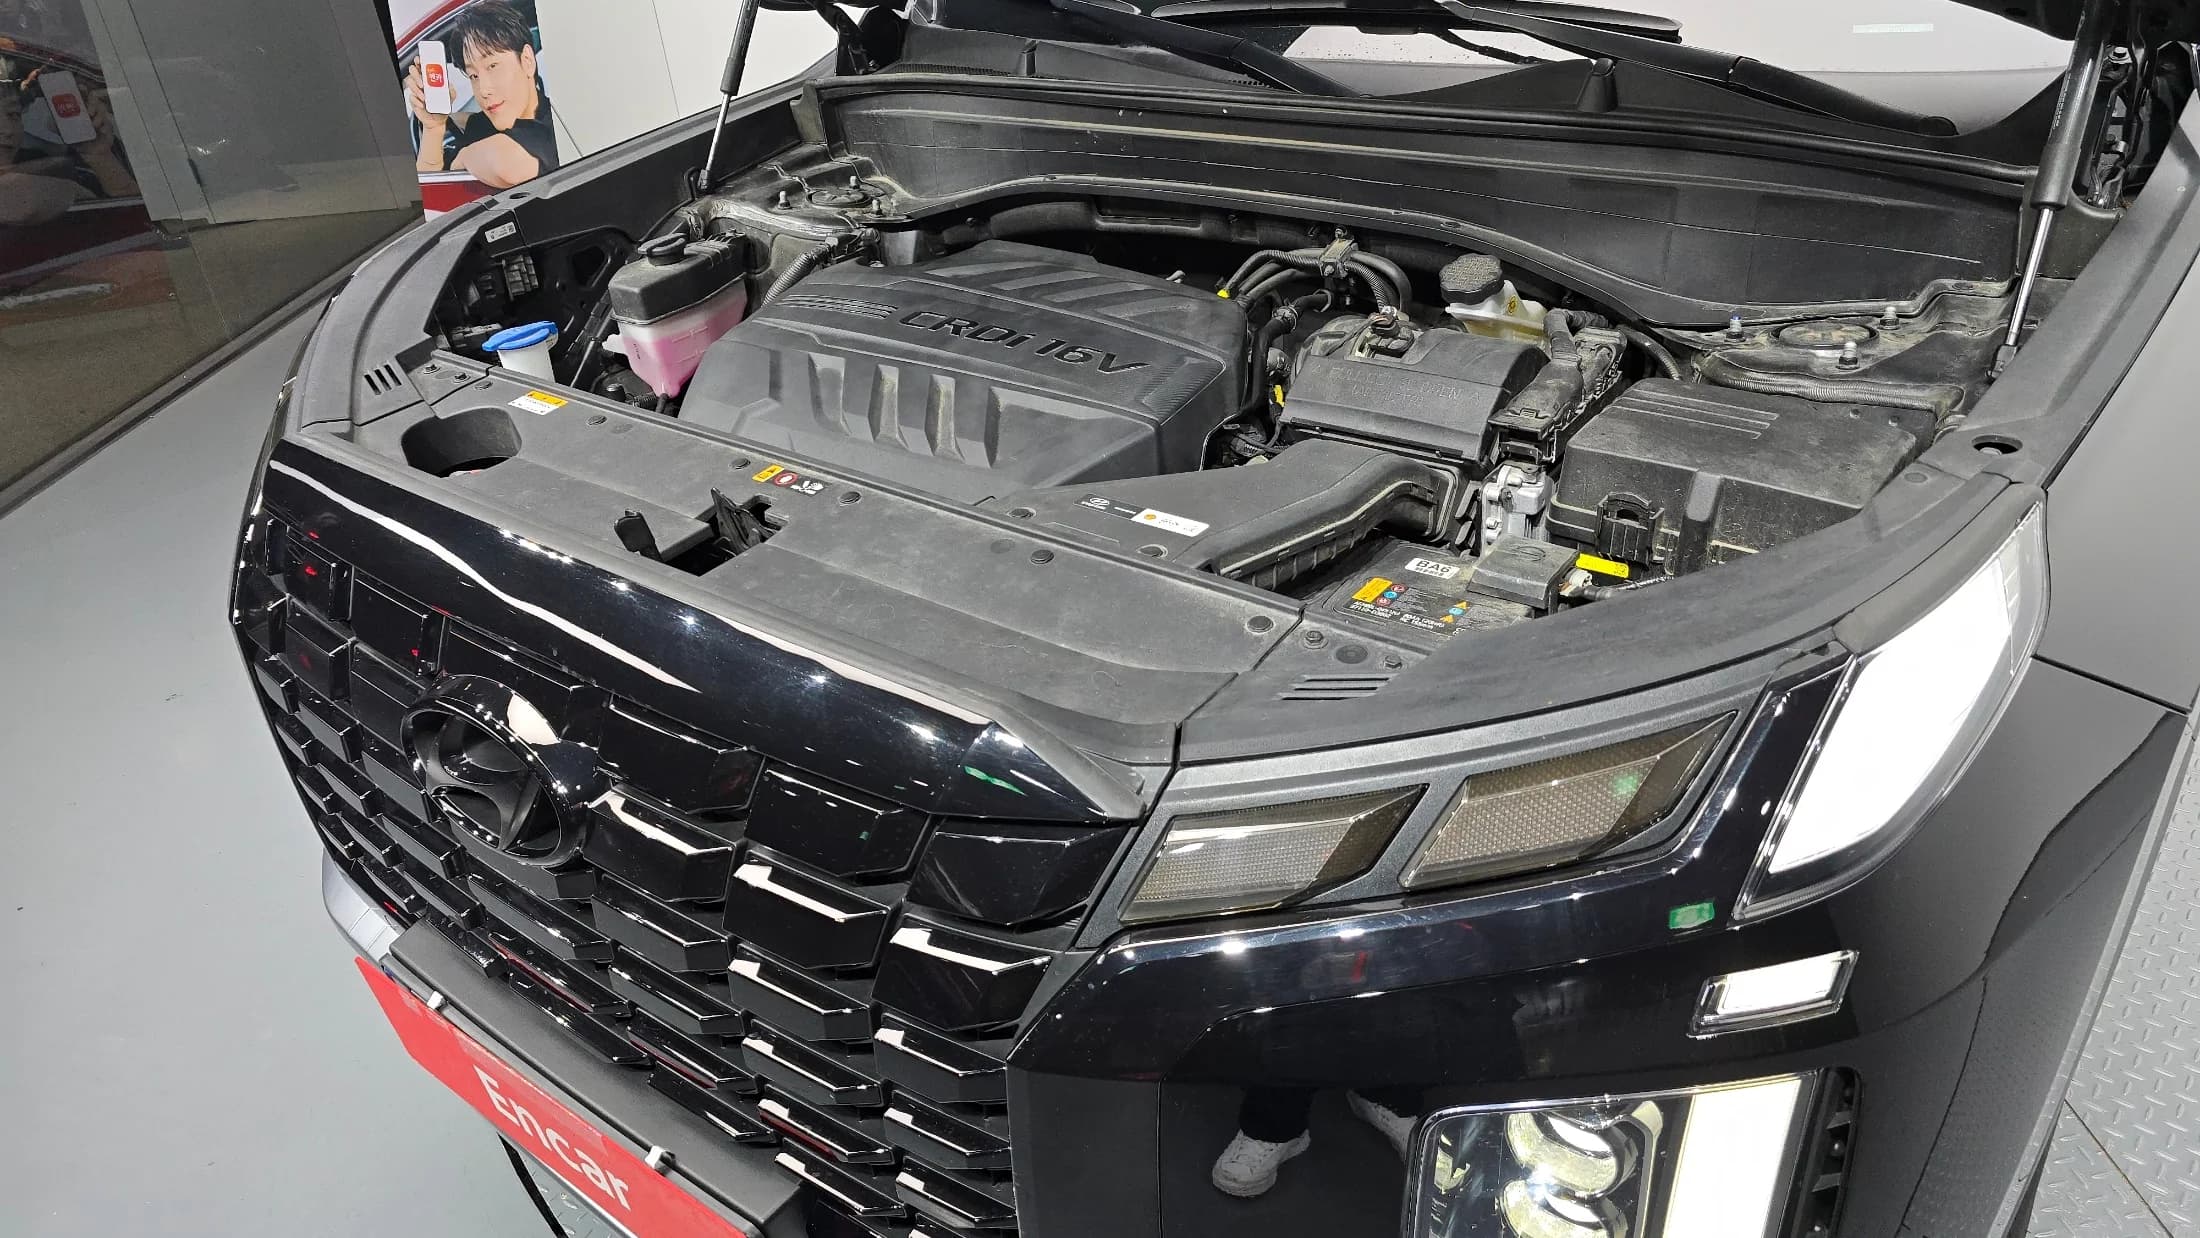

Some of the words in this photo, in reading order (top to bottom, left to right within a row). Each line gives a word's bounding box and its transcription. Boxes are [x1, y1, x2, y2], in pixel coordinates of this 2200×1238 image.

[899, 310, 1037, 349] CRDi
[1034, 337, 1152, 375] 16V
[1416, 560, 1452, 573] BA6
[473, 1064, 631, 1211] Encar
